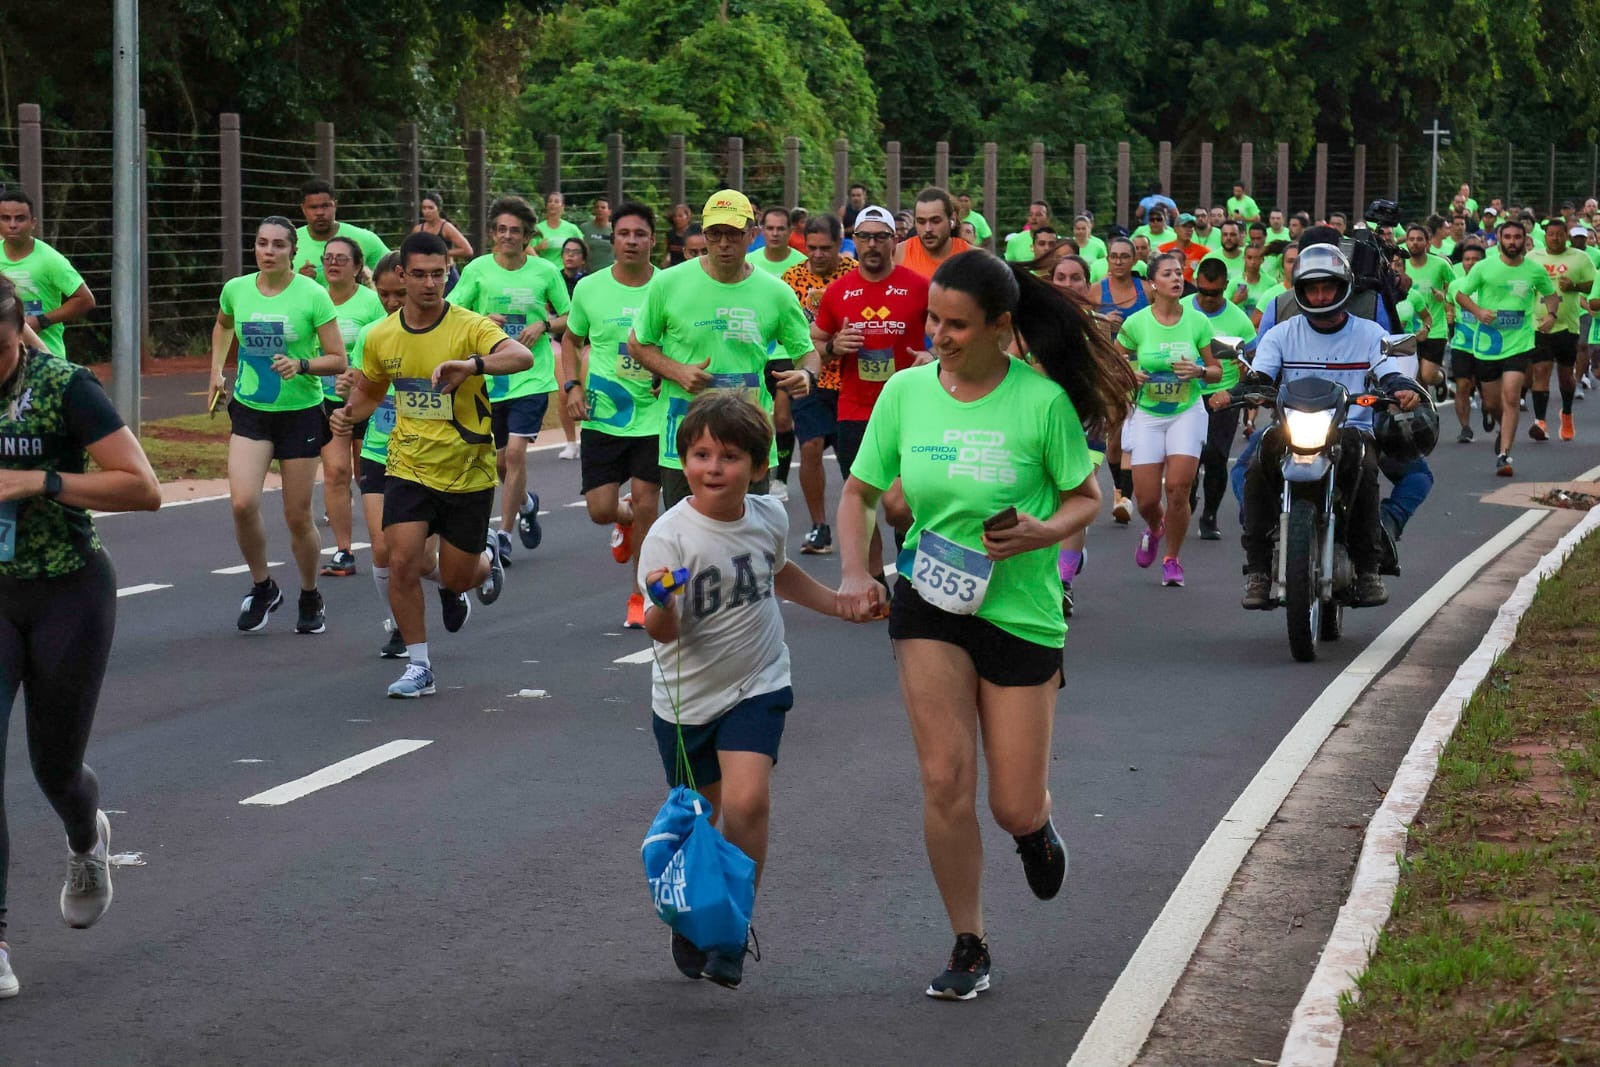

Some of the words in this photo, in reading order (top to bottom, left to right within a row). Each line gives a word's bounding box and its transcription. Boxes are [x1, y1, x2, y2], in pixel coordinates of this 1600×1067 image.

[246, 335, 284, 348] 1070
[862, 360, 890, 373] 337
[1155, 382, 1183, 395] 187
[406, 392, 442, 409] 325
[0, 437, 43, 456] NRA
[943, 429, 1006, 447] PO
[911, 445, 957, 453] CORRIDA
[959, 447, 1011, 466] DE
[916, 557, 977, 602] 2553
